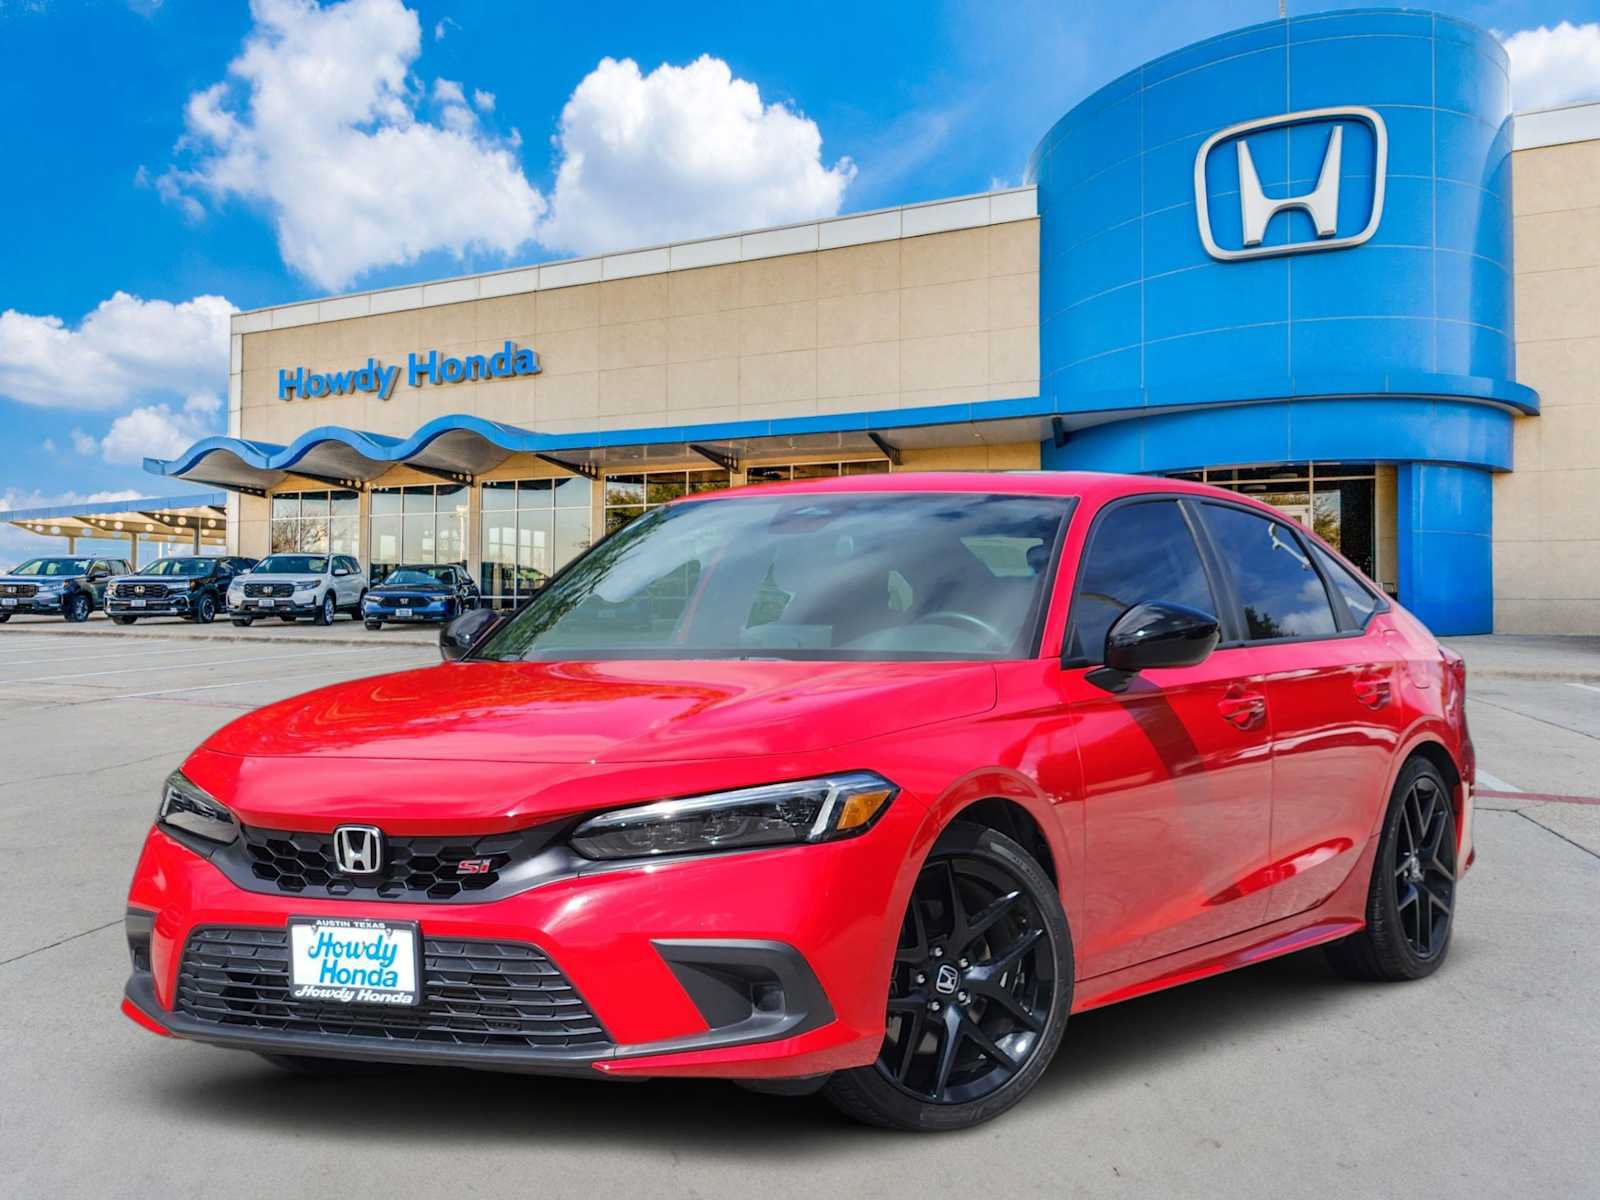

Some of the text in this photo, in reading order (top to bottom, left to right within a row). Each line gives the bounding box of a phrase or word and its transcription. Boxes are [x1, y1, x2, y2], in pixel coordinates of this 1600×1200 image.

[278, 340, 542, 401] Howdy Honda
[316, 919, 386, 929] AUSTIN TEXAS
[308, 931, 398, 968] Howdy
[319, 959, 399, 988] Honda
[294, 985, 414, 1004] Howdy Honda
